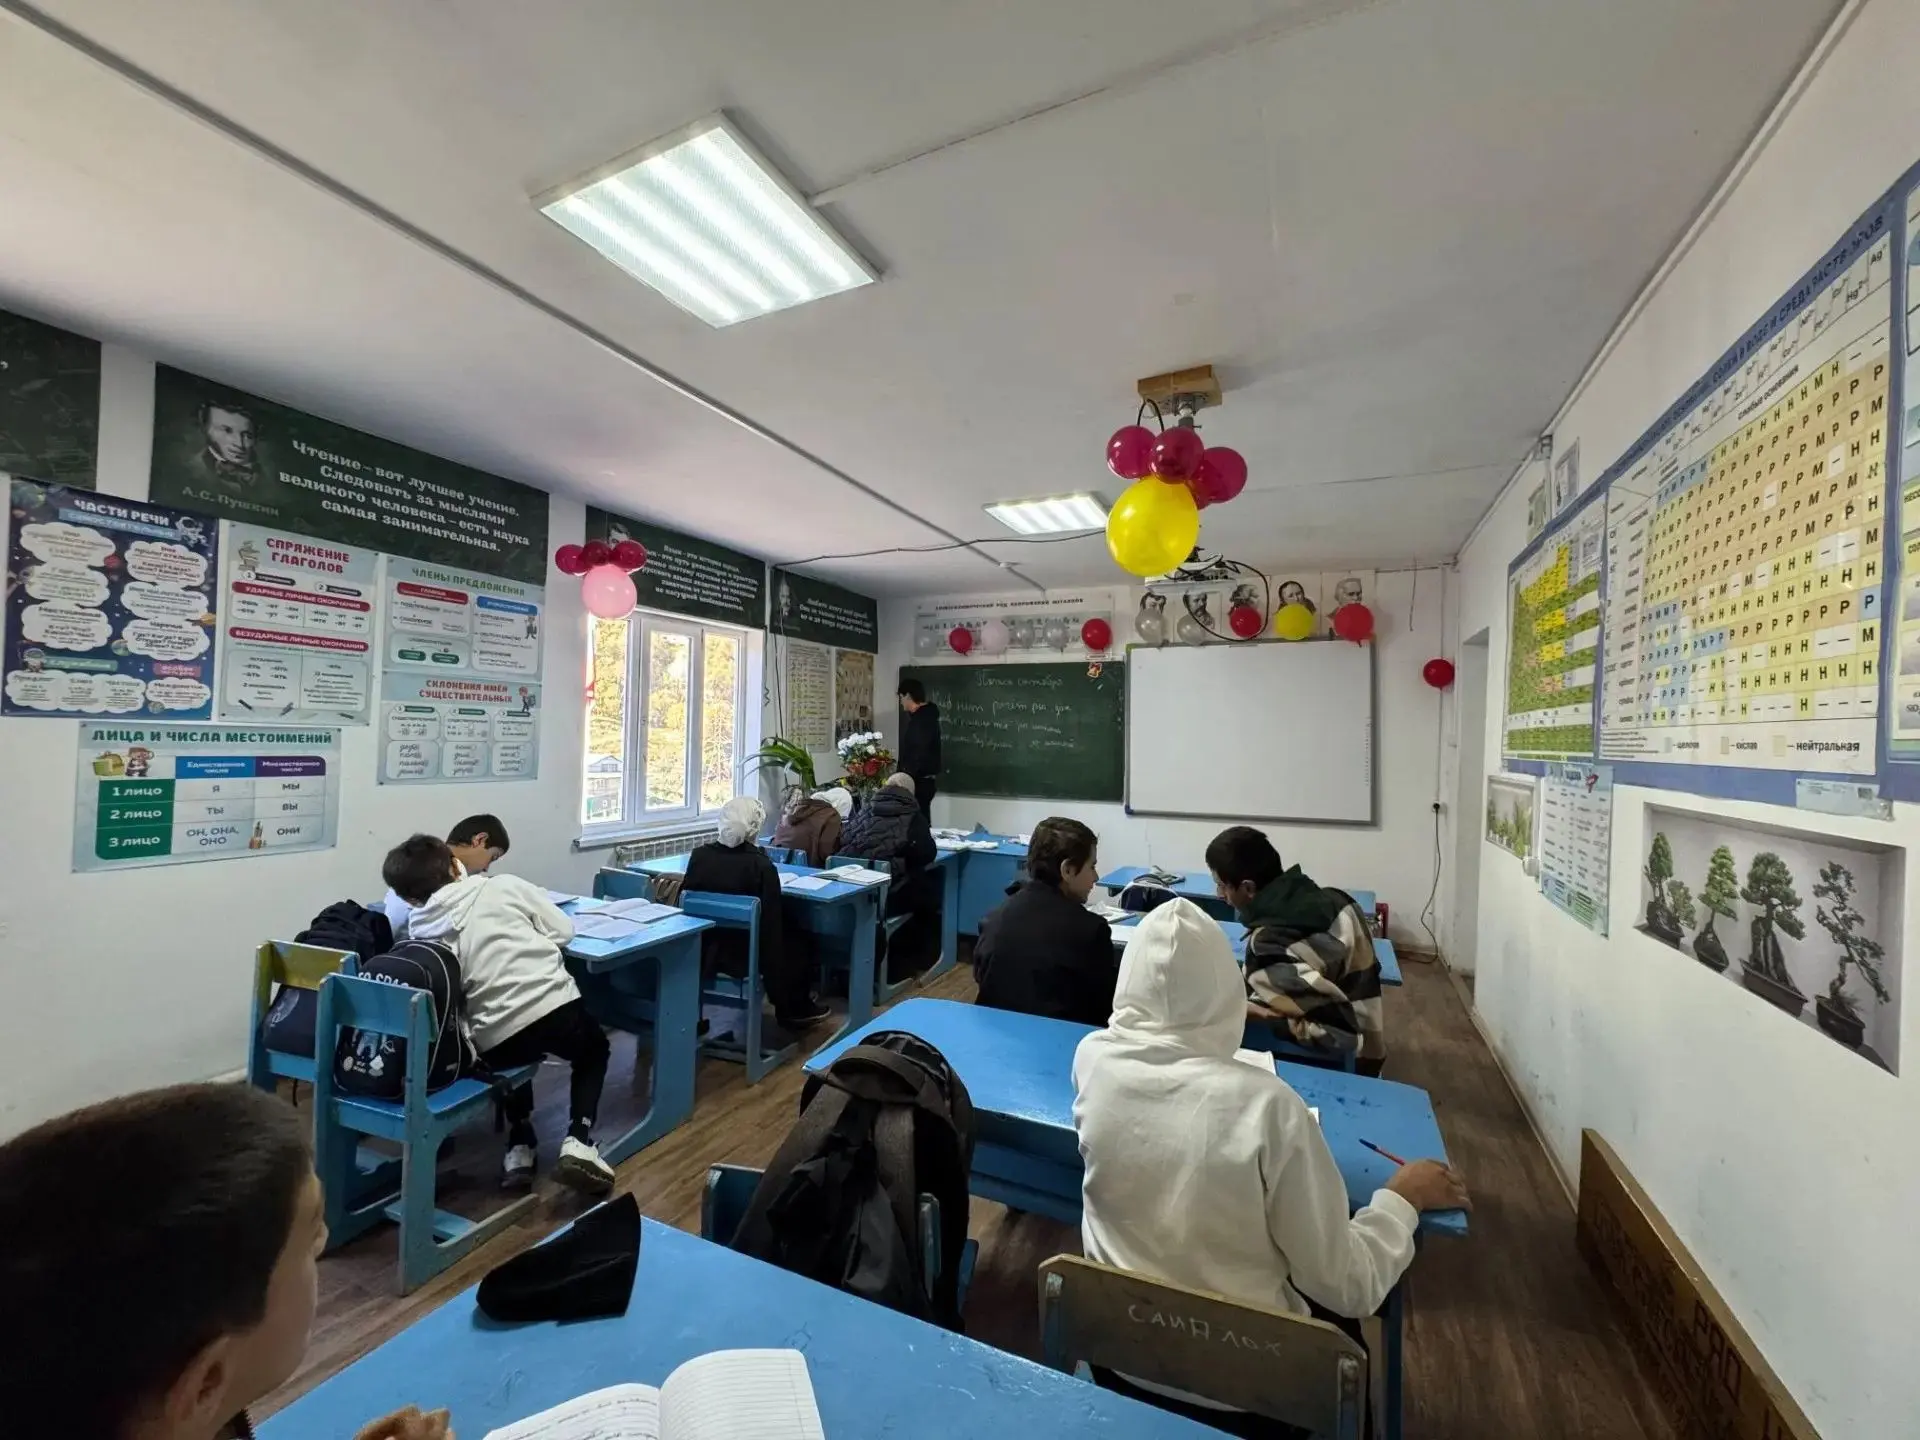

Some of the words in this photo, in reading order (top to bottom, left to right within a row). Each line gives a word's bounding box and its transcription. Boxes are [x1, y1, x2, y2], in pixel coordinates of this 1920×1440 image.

[1788, 397, 1794, 412] Н
[1801, 386, 1808, 400] Н
[1814, 373, 1823, 390] М
[1832, 360, 1840, 377] Н
[1786, 425, 1794, 439] Р
[1802, 414, 1809, 429] Р
[1817, 404, 1823, 417] Р
[1832, 392, 1840, 407] Р
[1850, 379, 1859, 394] Р
[1874, 364, 1884, 381] Р
[1783, 452, 1790, 466] Р
[1799, 443, 1807, 457] Р
[1816, 432, 1825, 448] М
[1832, 422, 1839, 436] Р
[1850, 410, 1860, 426] Р
[1871, 395, 1883, 414] М
[1796, 472, 1804, 485] Р
[1812, 461, 1824, 478] М
[1851, 440, 1860, 457] Н
[1870, 429, 1880, 446] Н
[292, 440, 361, 470] Чтение
[376, 467, 404, 482] вот
[408, 476, 464, 501] лучшее
[320, 465, 412, 500] Следовать
[416, 494, 434, 506] за
[439, 498, 506, 526] мыслями
[1793, 500, 1800, 514] Р
[1808, 490, 1820, 506] М
[1829, 482, 1838, 497] Р
[1847, 472, 1858, 489] М
[74, 498, 129, 521] ЧАСТИ
[131, 510, 170, 526] РЕЧИ
[279, 470, 366, 502] великого
[372, 496, 446, 525] человека
[459, 519, 490, 535] есть
[493, 528, 530, 546] наука
[321, 499, 377, 522] самая
[1790, 529, 1798, 542] Р
[1806, 520, 1816, 536] М
[1824, 513, 1833, 528] Р
[1845, 504, 1854, 520] Р
[1868, 495, 1878, 512] Н
[266, 537, 350, 562] СПРЯЖЕНИЕ
[1788, 557, 1796, 570] Н
[1804, 550, 1812, 564] Н
[1866, 528, 1878, 544] М
[271, 551, 344, 574] ГЛАГОЛОВ
[245, 585, 284, 598] УДАРНЫЕ
[412, 567, 450, 582] ЧЛЕНЫ
[453, 575, 525, 597] ПРЕДЛОЖЕНИЯ
[1787, 585, 1795, 599] Н
[1803, 580, 1811, 594] Н
[1820, 574, 1828, 588] Н
[1841, 568, 1852, 583] Н
[1866, 561, 1876, 577] Н
[1786, 614, 1793, 627] Р
[1803, 610, 1810, 623] Р
[1820, 605, 1828, 619] Р
[1840, 600, 1850, 614] Р
[1864, 594, 1874, 610] Р
[235, 630, 288, 642] БЕЗУДАРНЫЕ
[1784, 643, 1792, 656] Н
[1800, 639, 1808, 652] Н
[1862, 626, 1874, 643] М
[1784, 672, 1790, 684] Н
[1800, 668, 1808, 682] Н
[1819, 666, 1827, 680] Н
[1838, 663, 1847, 677] Н
[1863, 660, 1872, 675] Н
[419, 689, 513, 703] СУЩЕСТВИТЕЛЬНЫХ
[426, 679, 481, 691] СКЛОНЕНИЯ
[1800, 698, 1808, 711] Н
[92, 730, 145, 743] ЛИЦА
[150, 731, 161, 742] И
[166, 731, 221, 743] ЧИСЛА
[225, 732, 332, 744] МЕСТОИМЕНИЙ
[1796, 741, 1860, 754] нейтральная
[112, 787, 120, 797] 1
[123, 786, 162, 797] лицо
[212, 785, 220, 793] Я
[110, 809, 119, 819] 2
[123, 808, 162, 820] лицо
[109, 837, 118, 847] 3
[122, 835, 160, 847] лицо
[199, 836, 227, 846] ОНО
[276, 826, 300, 836] ОНИ
